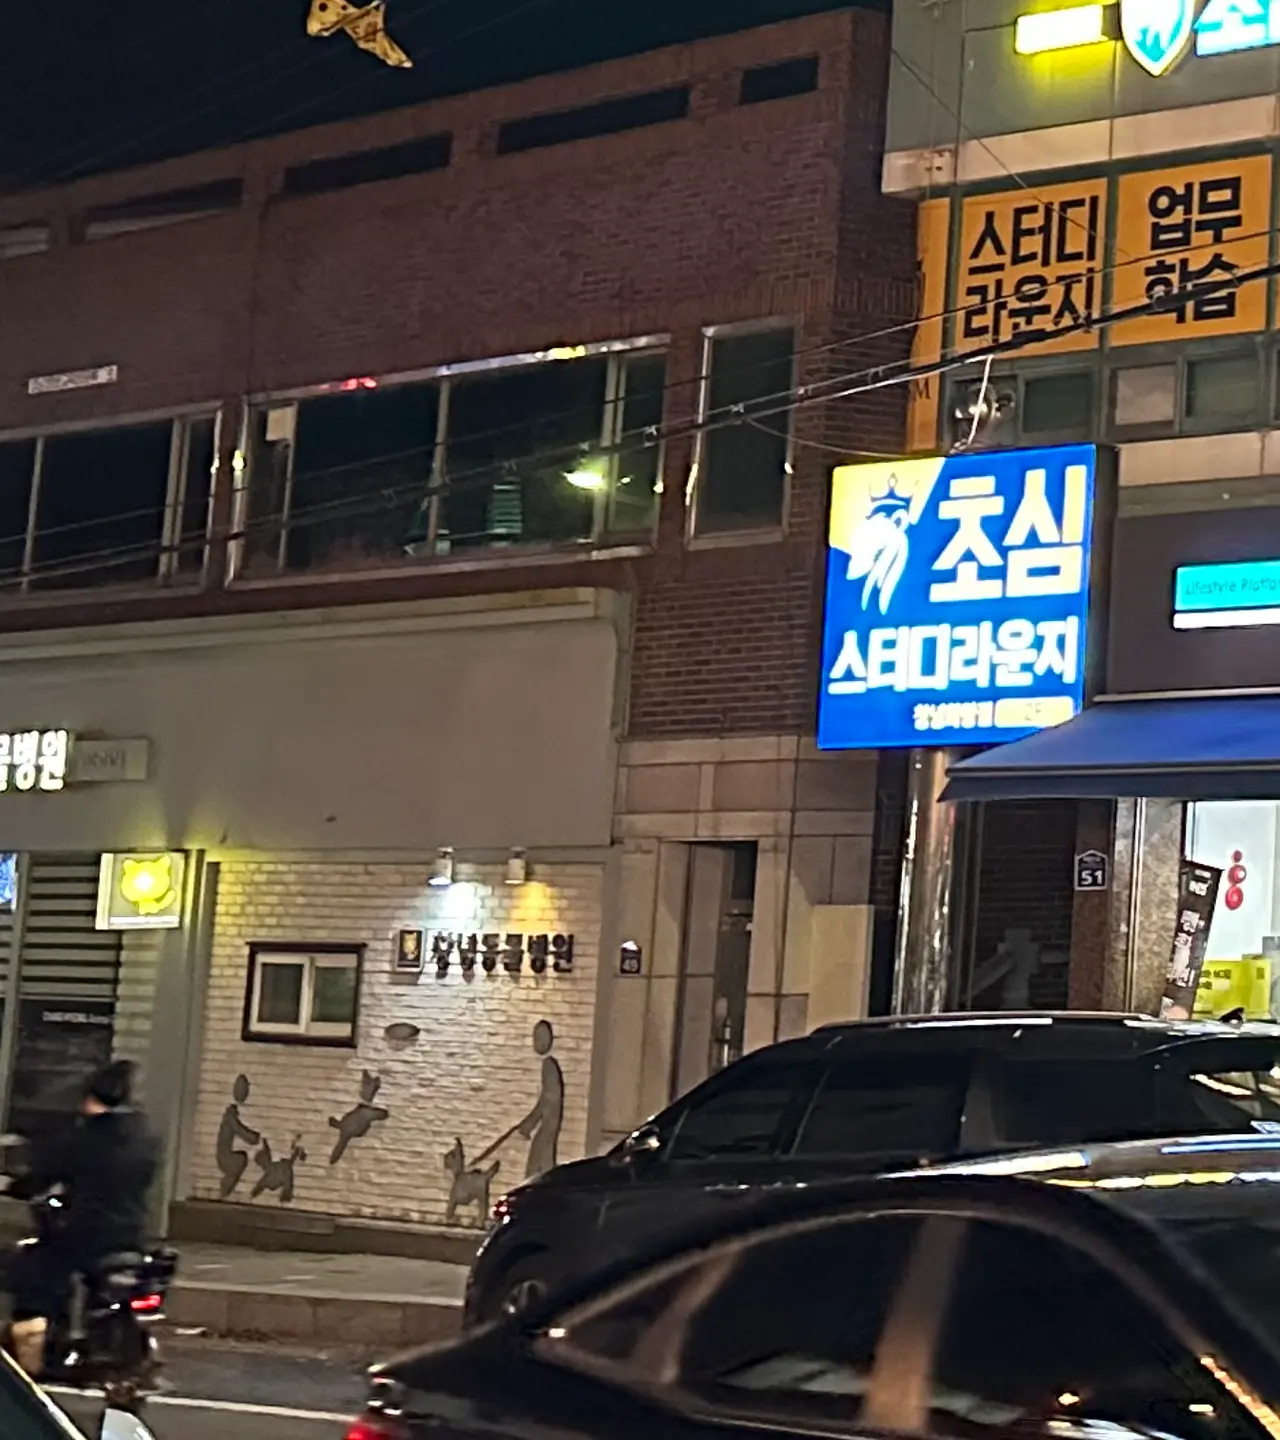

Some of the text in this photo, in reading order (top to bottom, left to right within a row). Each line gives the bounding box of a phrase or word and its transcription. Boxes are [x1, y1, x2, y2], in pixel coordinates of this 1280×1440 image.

[967, 195, 1100, 276] 스터디
[1148, 176, 1242, 251] 업무
[963, 267, 1096, 339] 라운지
[1144, 252, 1238, 325] 학습
[929, 464, 1087, 603] 초심
[828, 616, 1079, 694] 스터디라운지
[1081, 870, 1103, 885] 51
